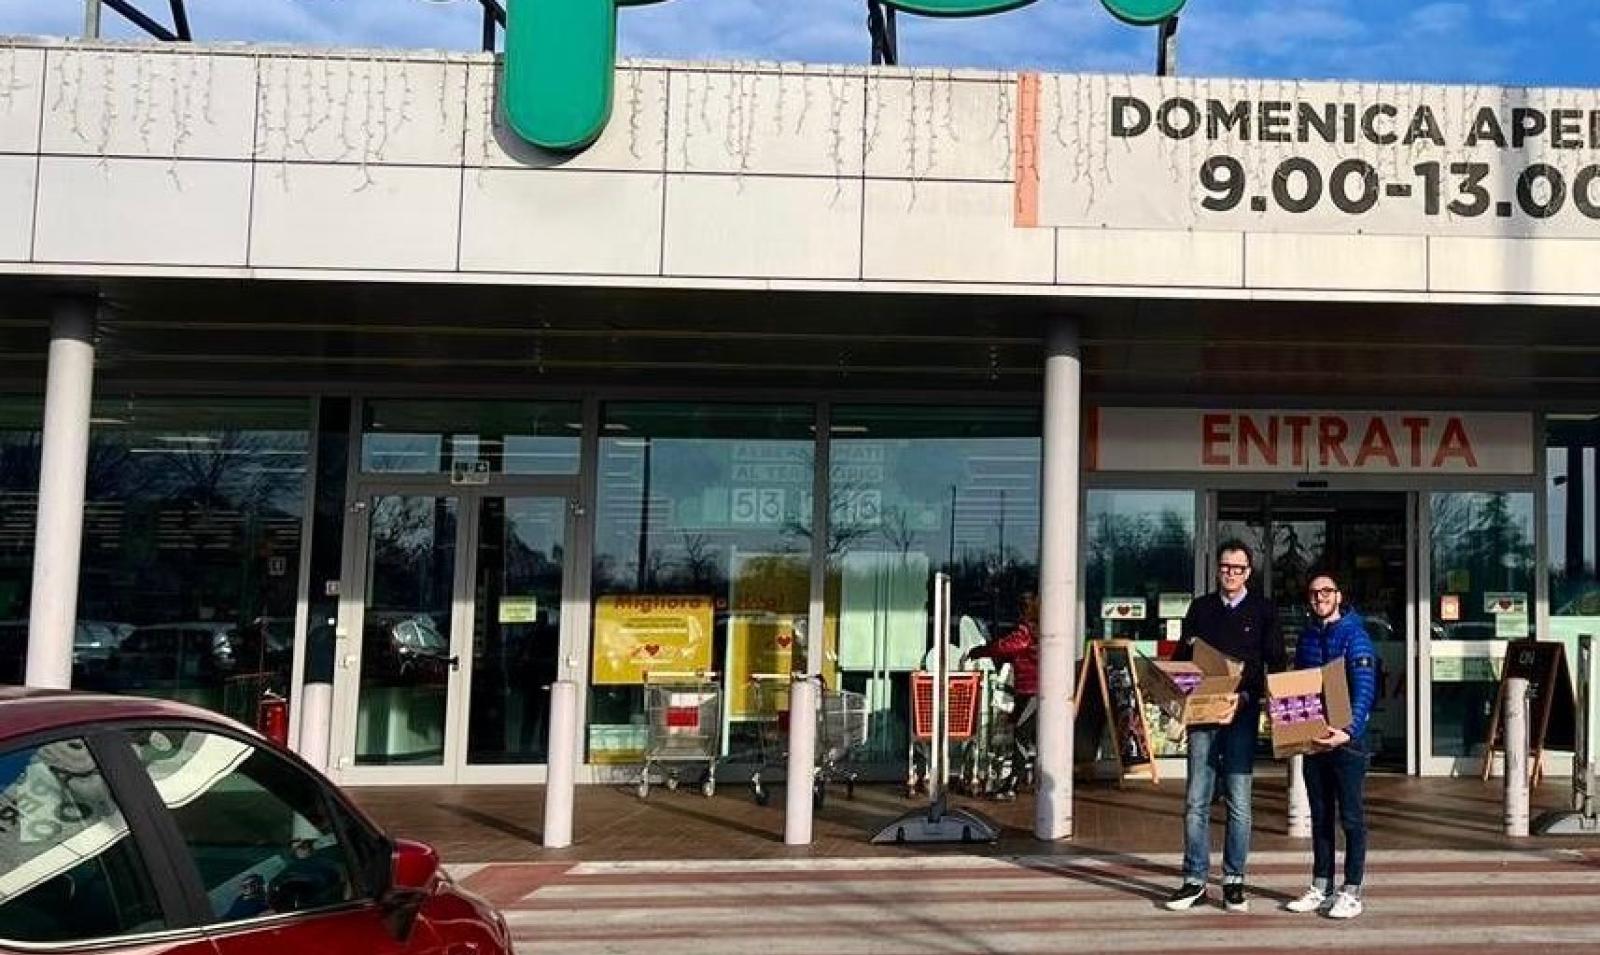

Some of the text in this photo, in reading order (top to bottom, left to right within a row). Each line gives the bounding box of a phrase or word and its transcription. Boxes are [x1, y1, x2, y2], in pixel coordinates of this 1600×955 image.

[1110, 95, 1600, 150] DOMENICA APE
[1202, 413, 1477, 467] ENTRATA
